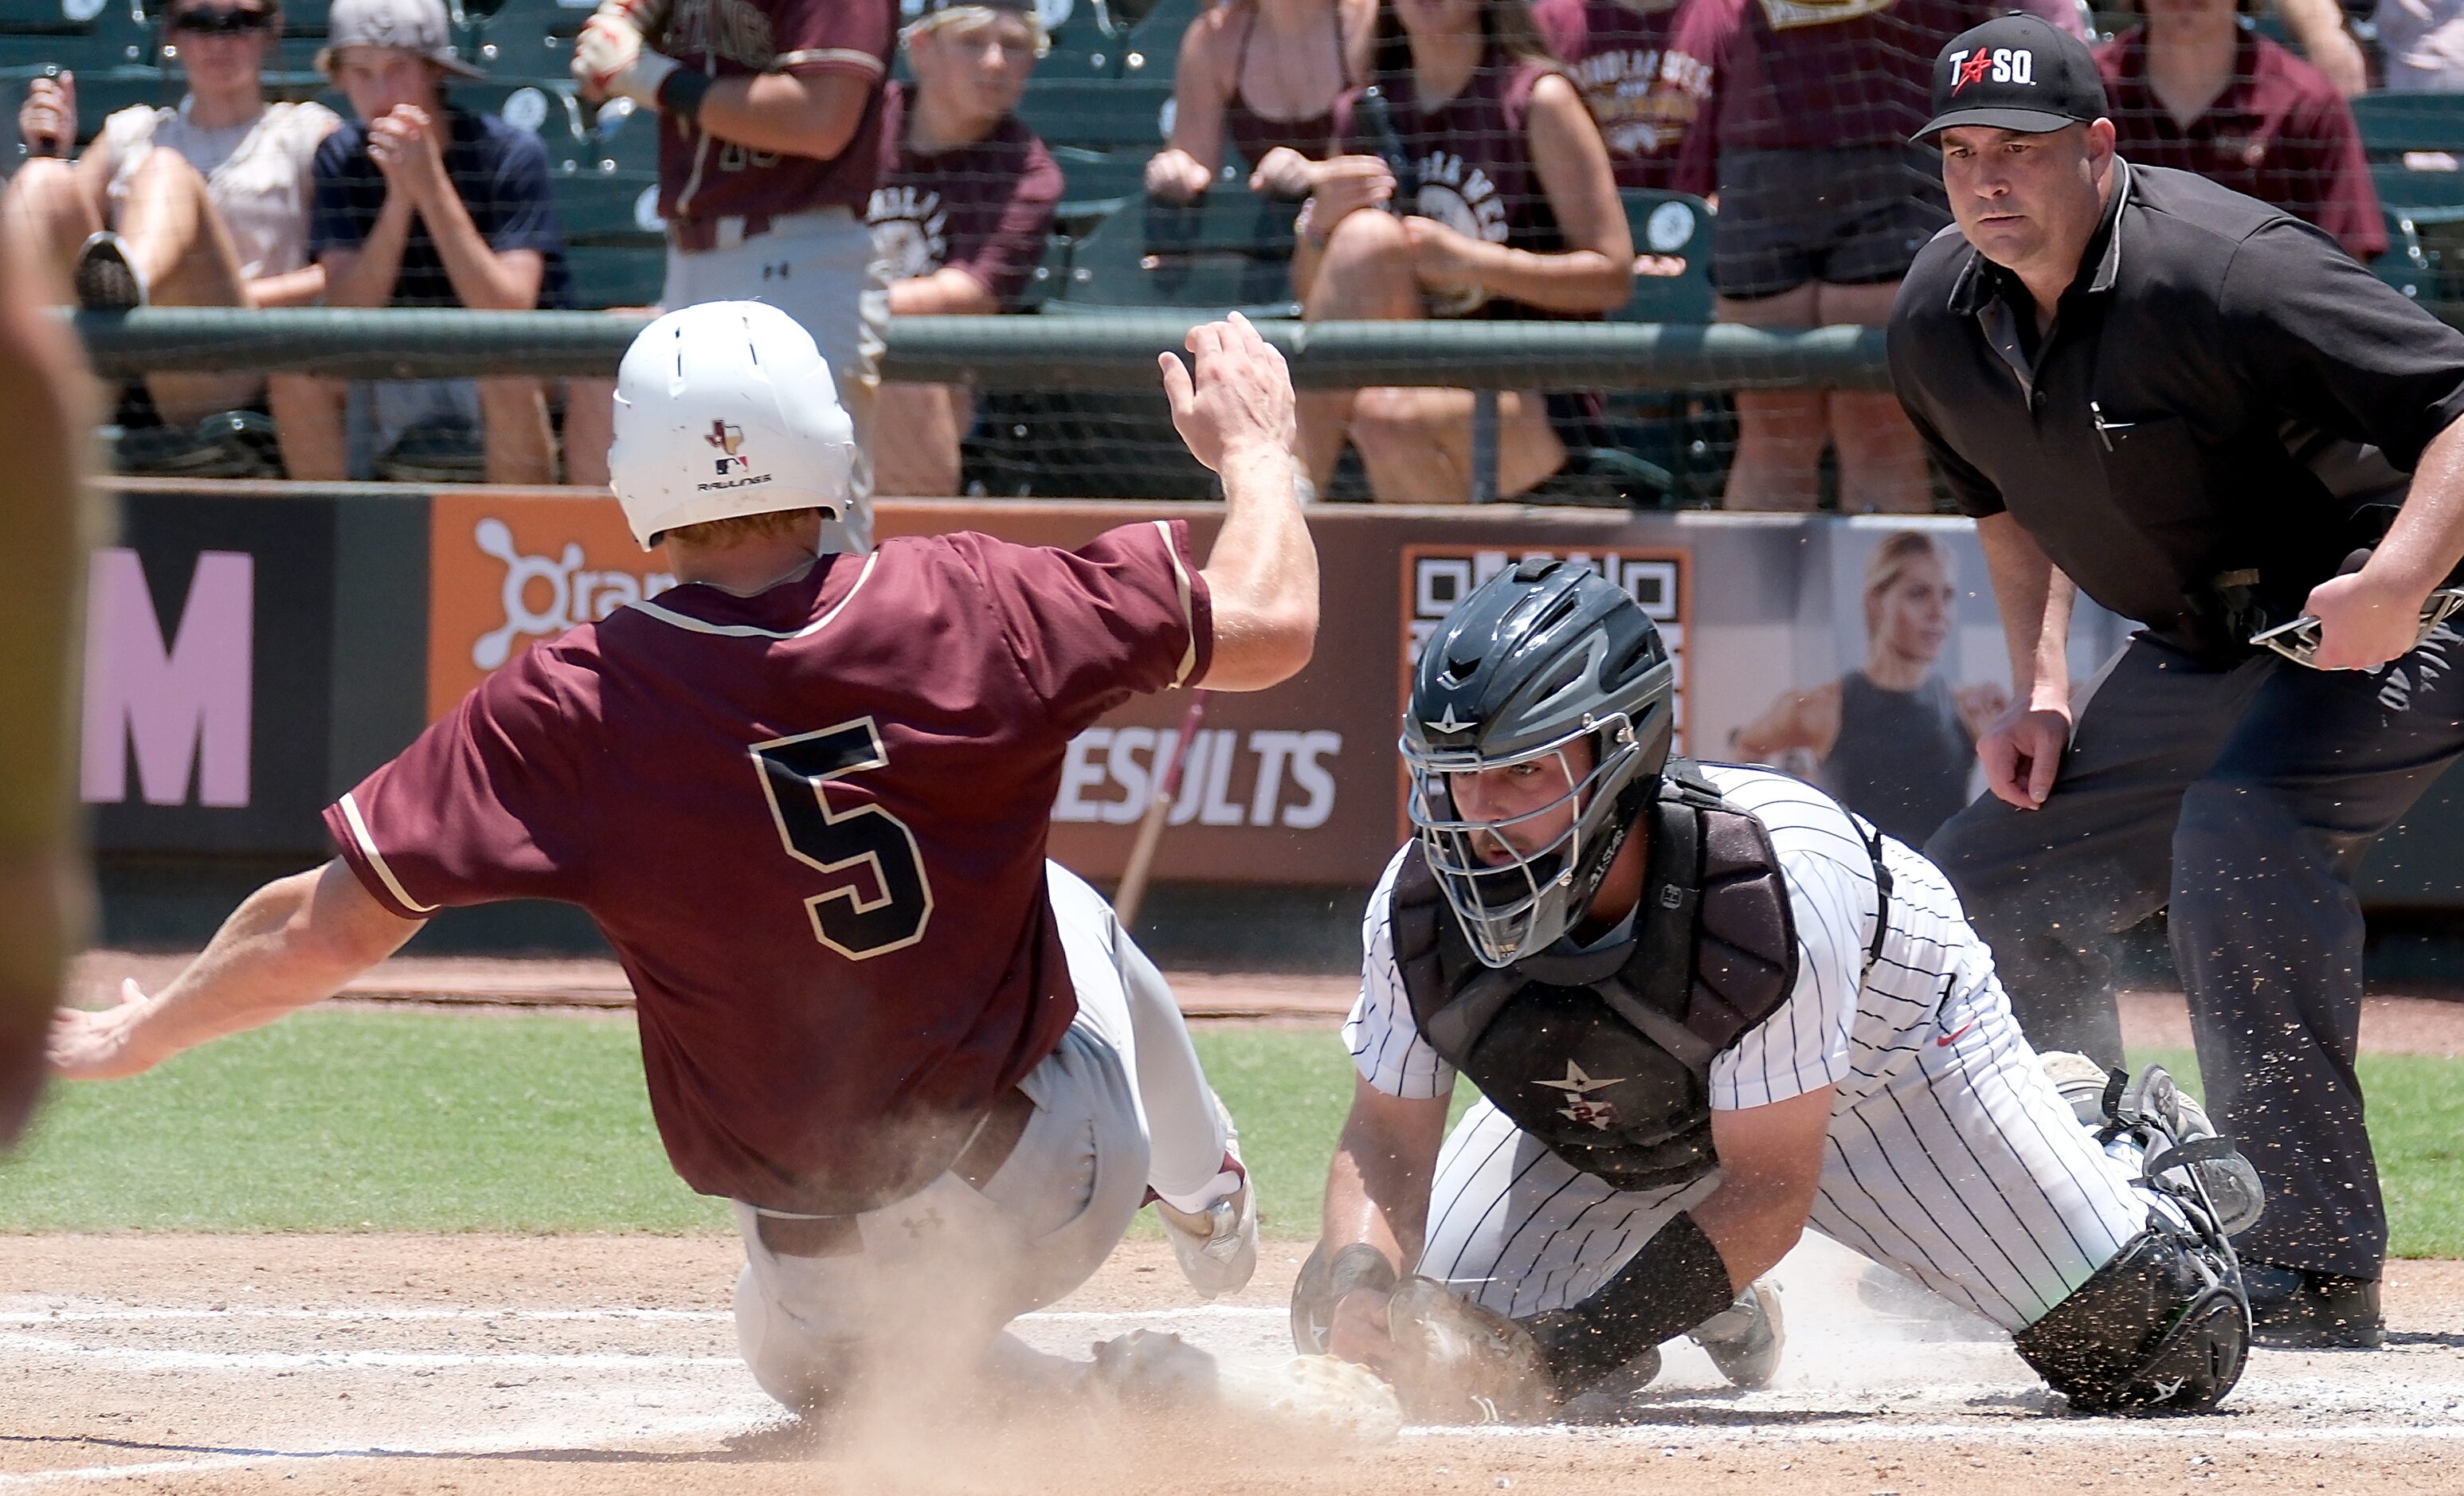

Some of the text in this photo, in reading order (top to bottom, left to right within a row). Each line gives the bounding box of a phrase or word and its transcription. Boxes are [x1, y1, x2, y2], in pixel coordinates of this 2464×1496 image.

[80, 546, 255, 809] M
[1050, 726, 1343, 829] ESULTS
[748, 715, 934, 961] 5
